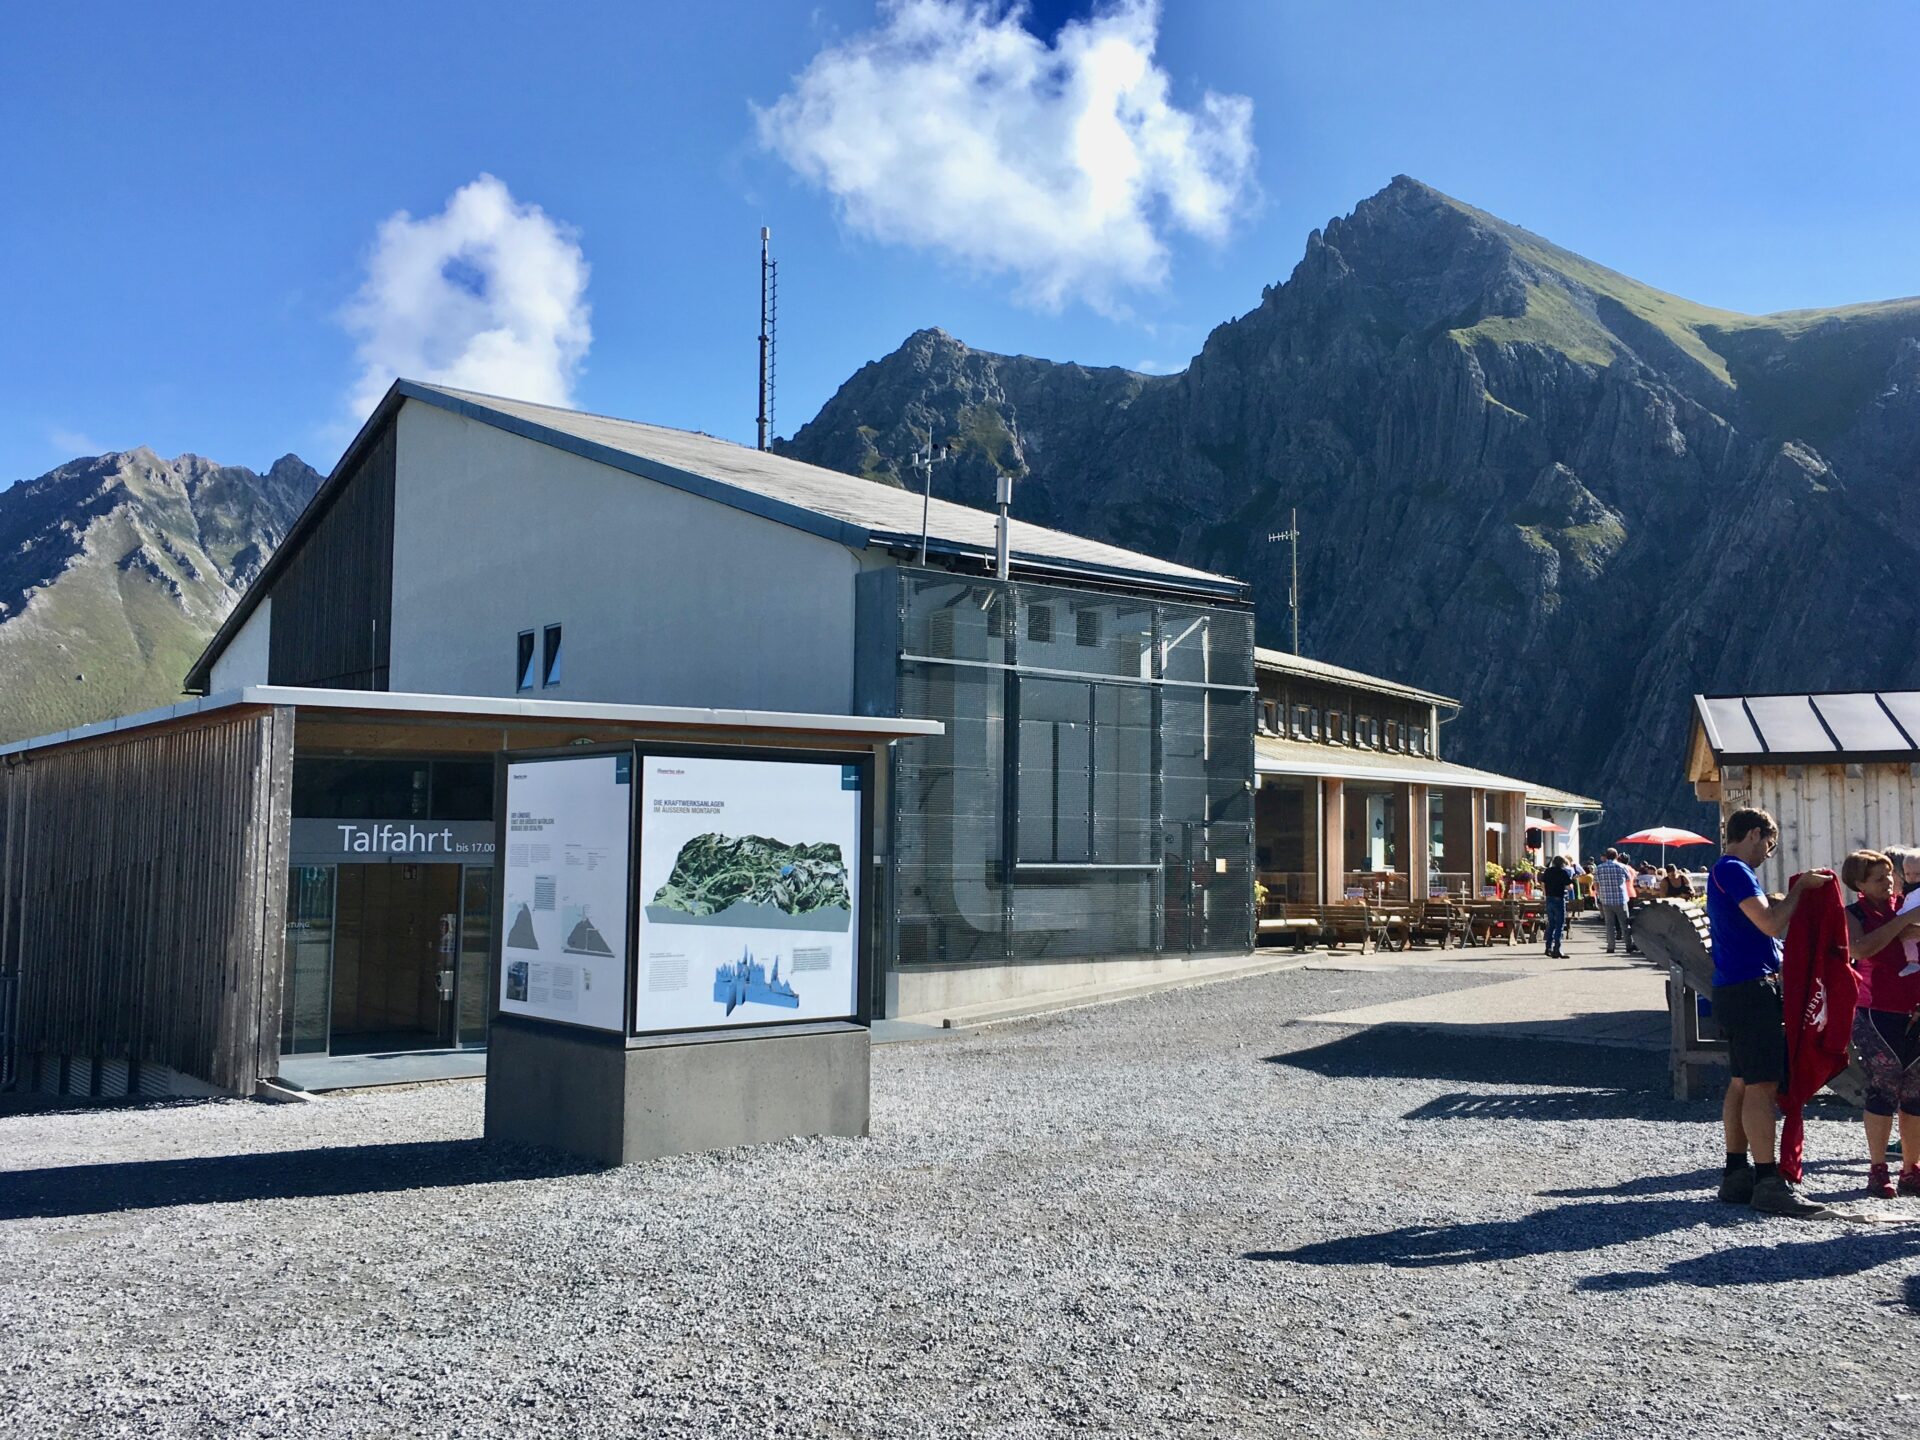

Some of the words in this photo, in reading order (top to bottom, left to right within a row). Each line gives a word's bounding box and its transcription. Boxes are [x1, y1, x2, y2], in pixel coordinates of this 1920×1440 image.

[337, 824, 453, 853] Talfahrt
[456, 843, 470, 853] bis
[472, 844, 496, 853] 17.00
